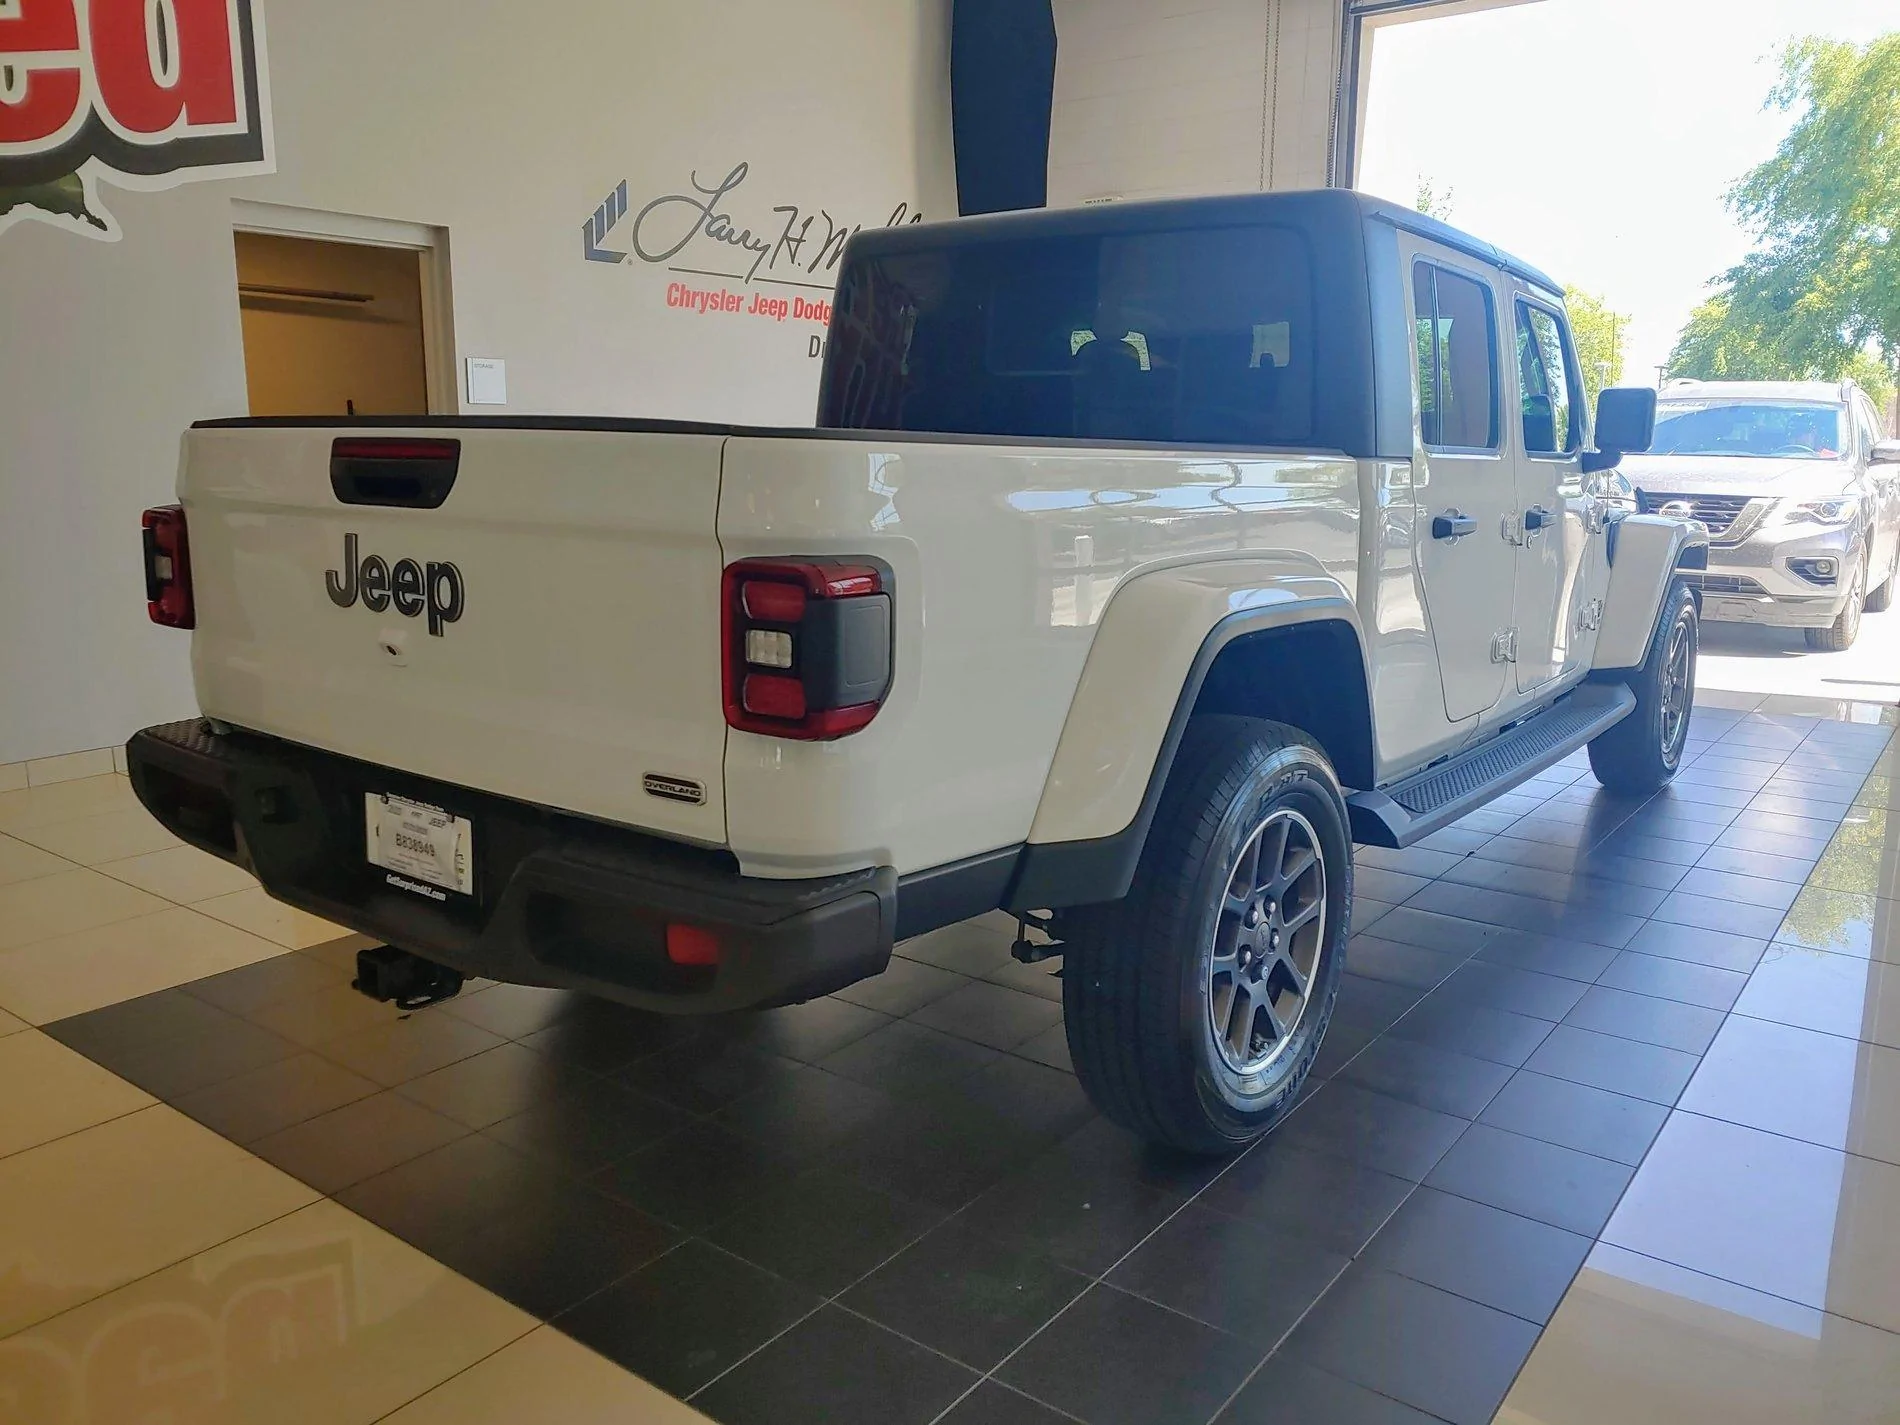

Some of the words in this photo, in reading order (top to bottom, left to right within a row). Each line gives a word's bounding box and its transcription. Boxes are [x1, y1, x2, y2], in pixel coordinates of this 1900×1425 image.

[632, 161, 772, 284] Larry
[666, 282, 745, 315] Chrysler
[748, 292, 789, 322] Jeep
[793, 296, 833, 326] Dodg
[325, 532, 465, 638] Jeep
[644, 780, 702, 797] OVERLAND
